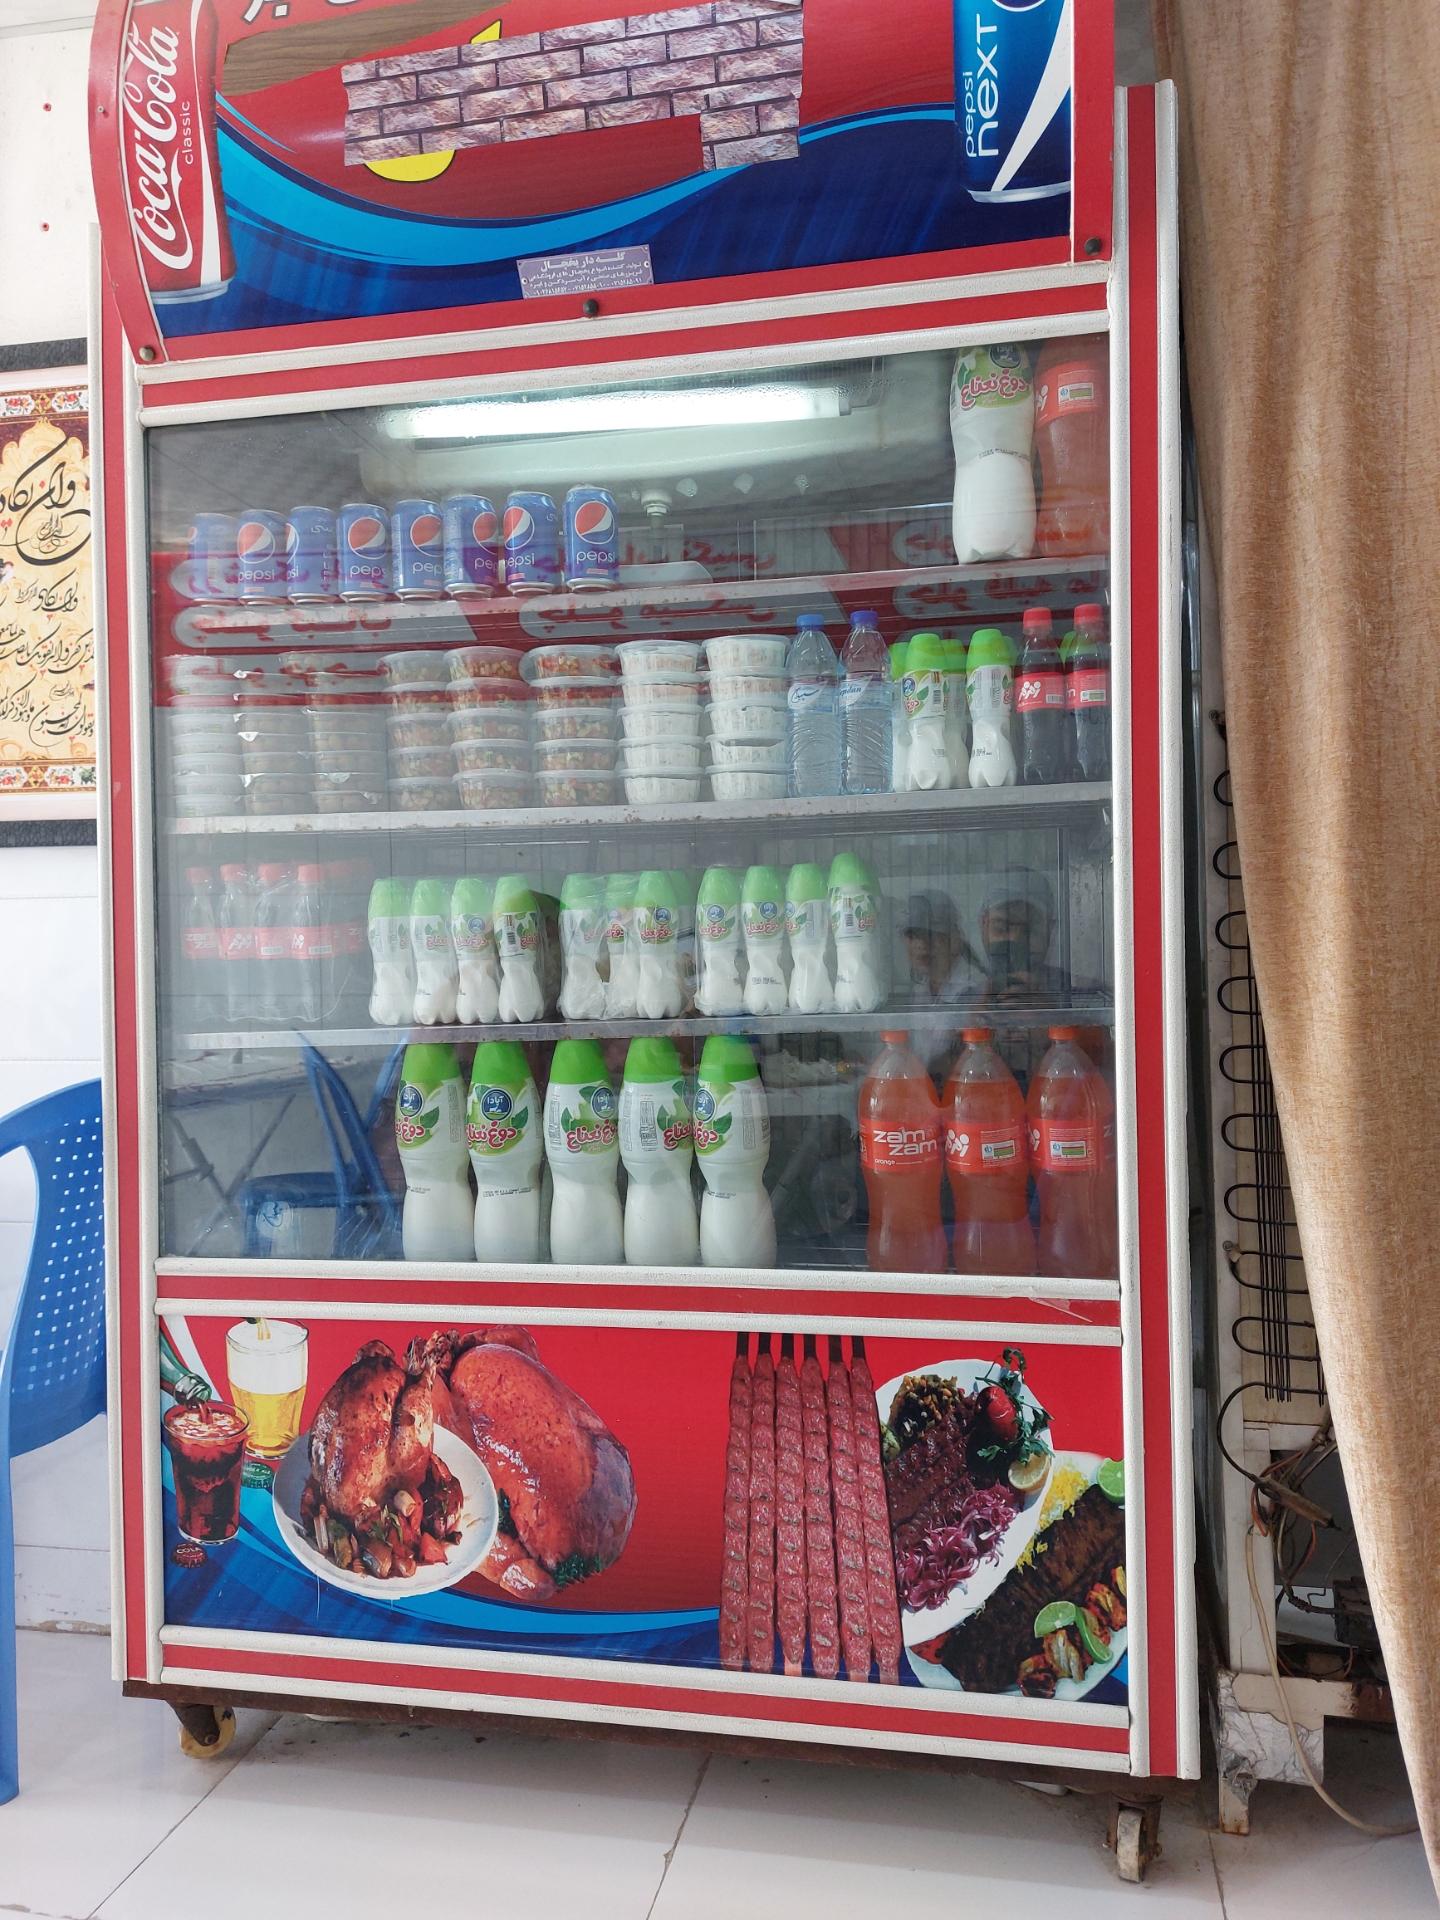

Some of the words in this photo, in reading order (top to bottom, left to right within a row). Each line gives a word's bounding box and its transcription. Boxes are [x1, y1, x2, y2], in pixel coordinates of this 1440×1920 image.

[963, 71, 977, 158] pepsi
[180, 100, 195, 165] classic
[576, 549, 615, 564] pepsi
[488, 1120, 517, 1149] دوغ
[566, 1123, 602, 1153] نعناع
[873, 1127, 926, 1143] zam
[889, 1139, 938, 1156] zam
